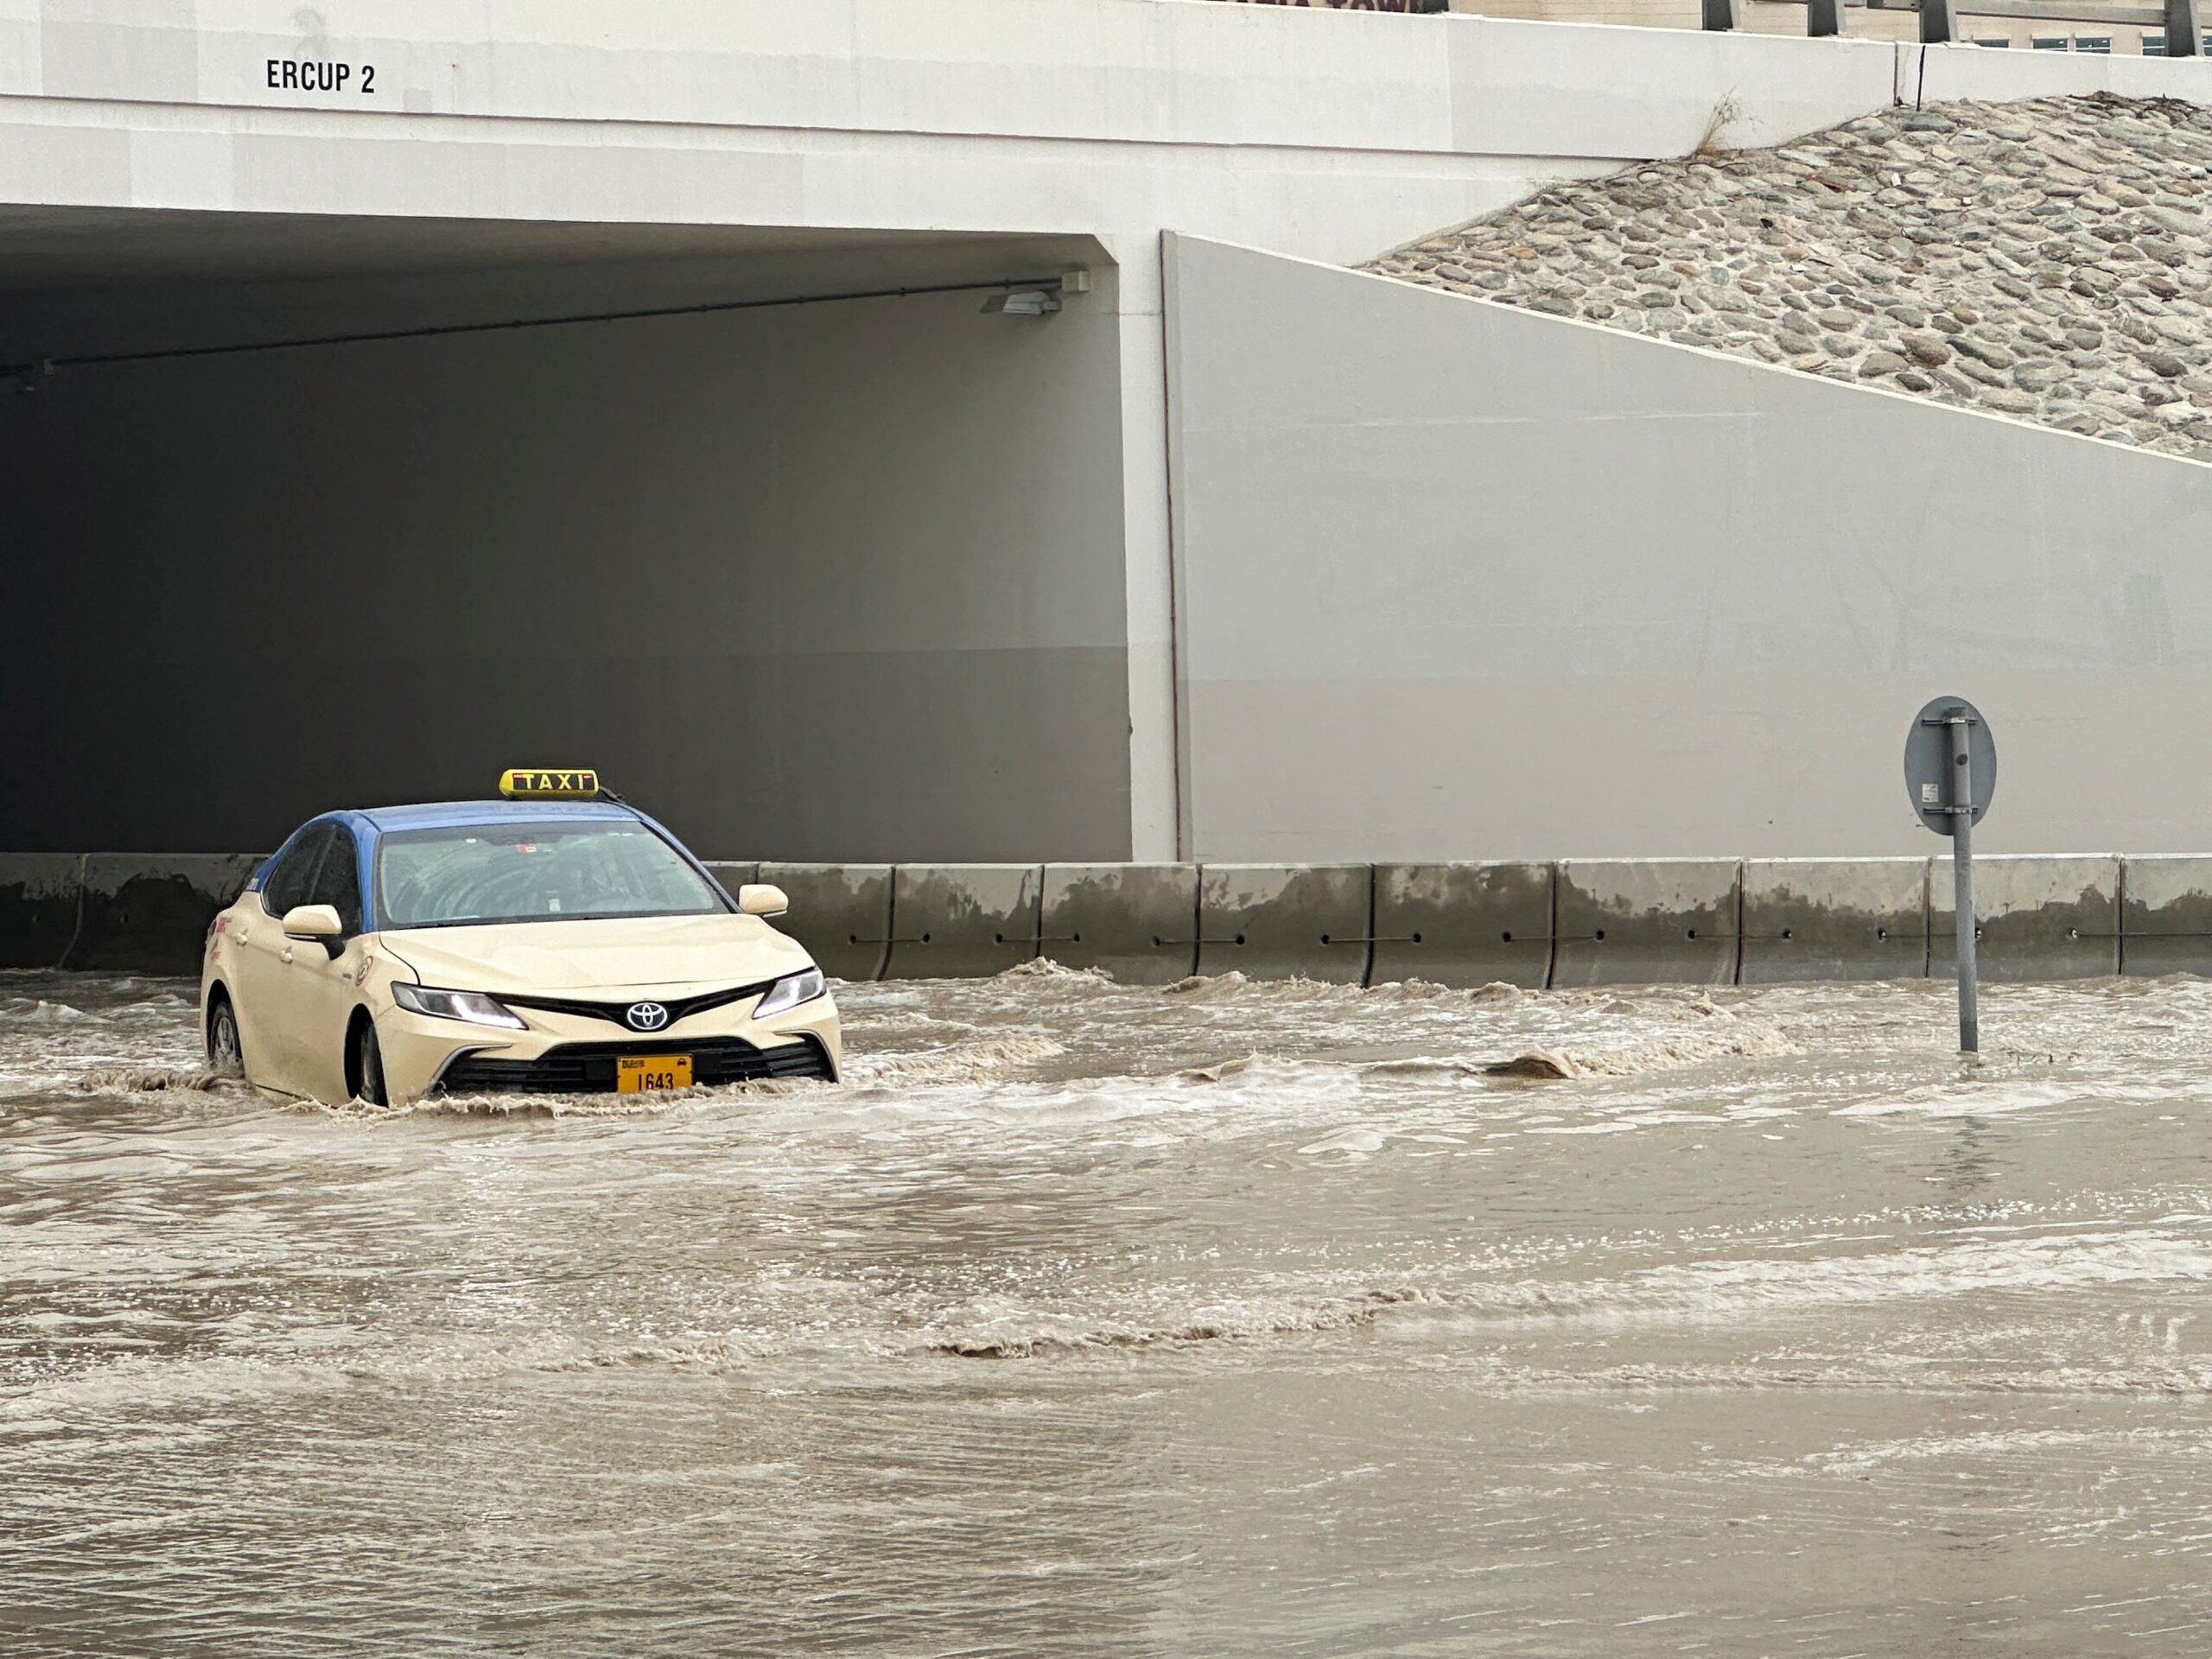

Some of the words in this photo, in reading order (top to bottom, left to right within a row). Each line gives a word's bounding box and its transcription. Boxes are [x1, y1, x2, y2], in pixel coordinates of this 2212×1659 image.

[267, 59, 350, 92] ERCUP
[361, 65, 375, 93] 2
[522, 773, 584, 790] TAXI
[638, 1072, 674, 1090] 1643
